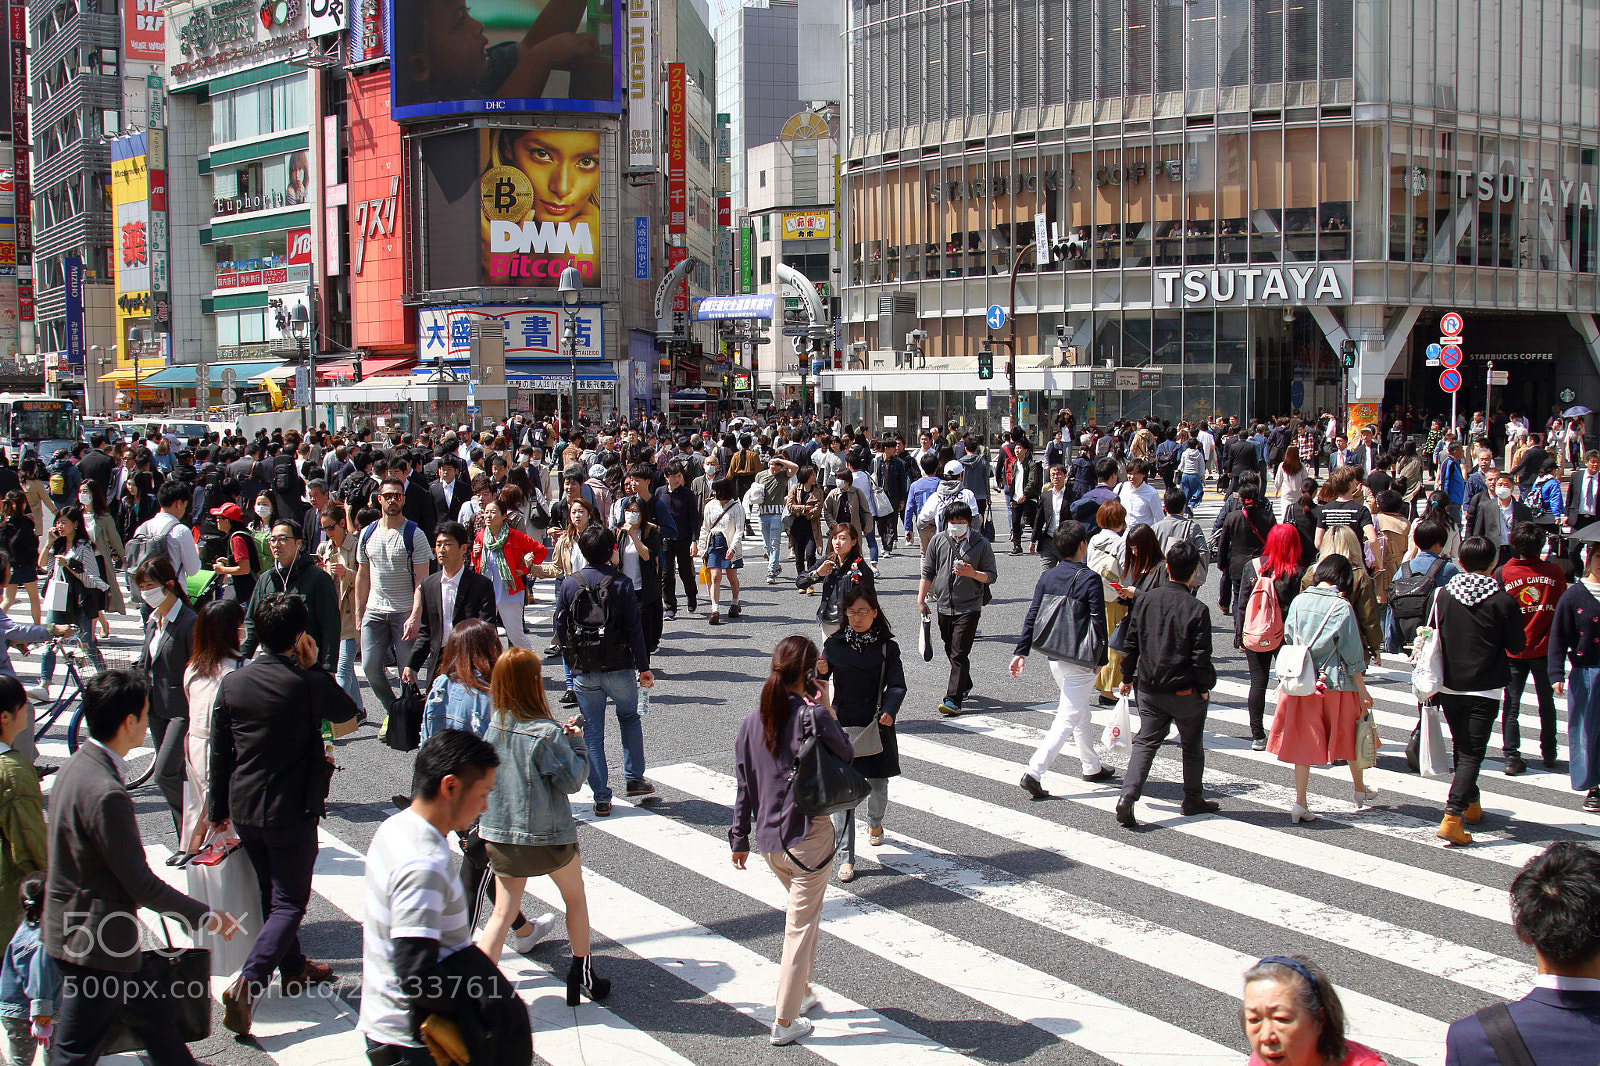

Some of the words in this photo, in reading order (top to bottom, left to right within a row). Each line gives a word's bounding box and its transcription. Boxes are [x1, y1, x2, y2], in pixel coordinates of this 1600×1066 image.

[137, 14, 163, 30] B2F
[632, 26, 646, 99] neon
[485, 101, 505, 109] DHC
[671, 68, 683, 160] クスリのことなら
[151, 186, 165, 194] JTB
[216, 189, 284, 214] Euphoria
[670, 169, 686, 226] 三千里
[1456, 169, 1593, 210] TSUTAYA
[355, 176, 399, 274] クスリ
[490, 221, 593, 253] DMM
[290, 232, 311, 259] JTB
[71, 266, 79, 297] MIZUHO
[1158, 267, 1343, 303] TSUTAYA
[1470, 353, 1518, 361] STARBUCKS
[1519, 353, 1553, 361] COFFEE
[1527, 576, 1556, 586] CAVERNS
